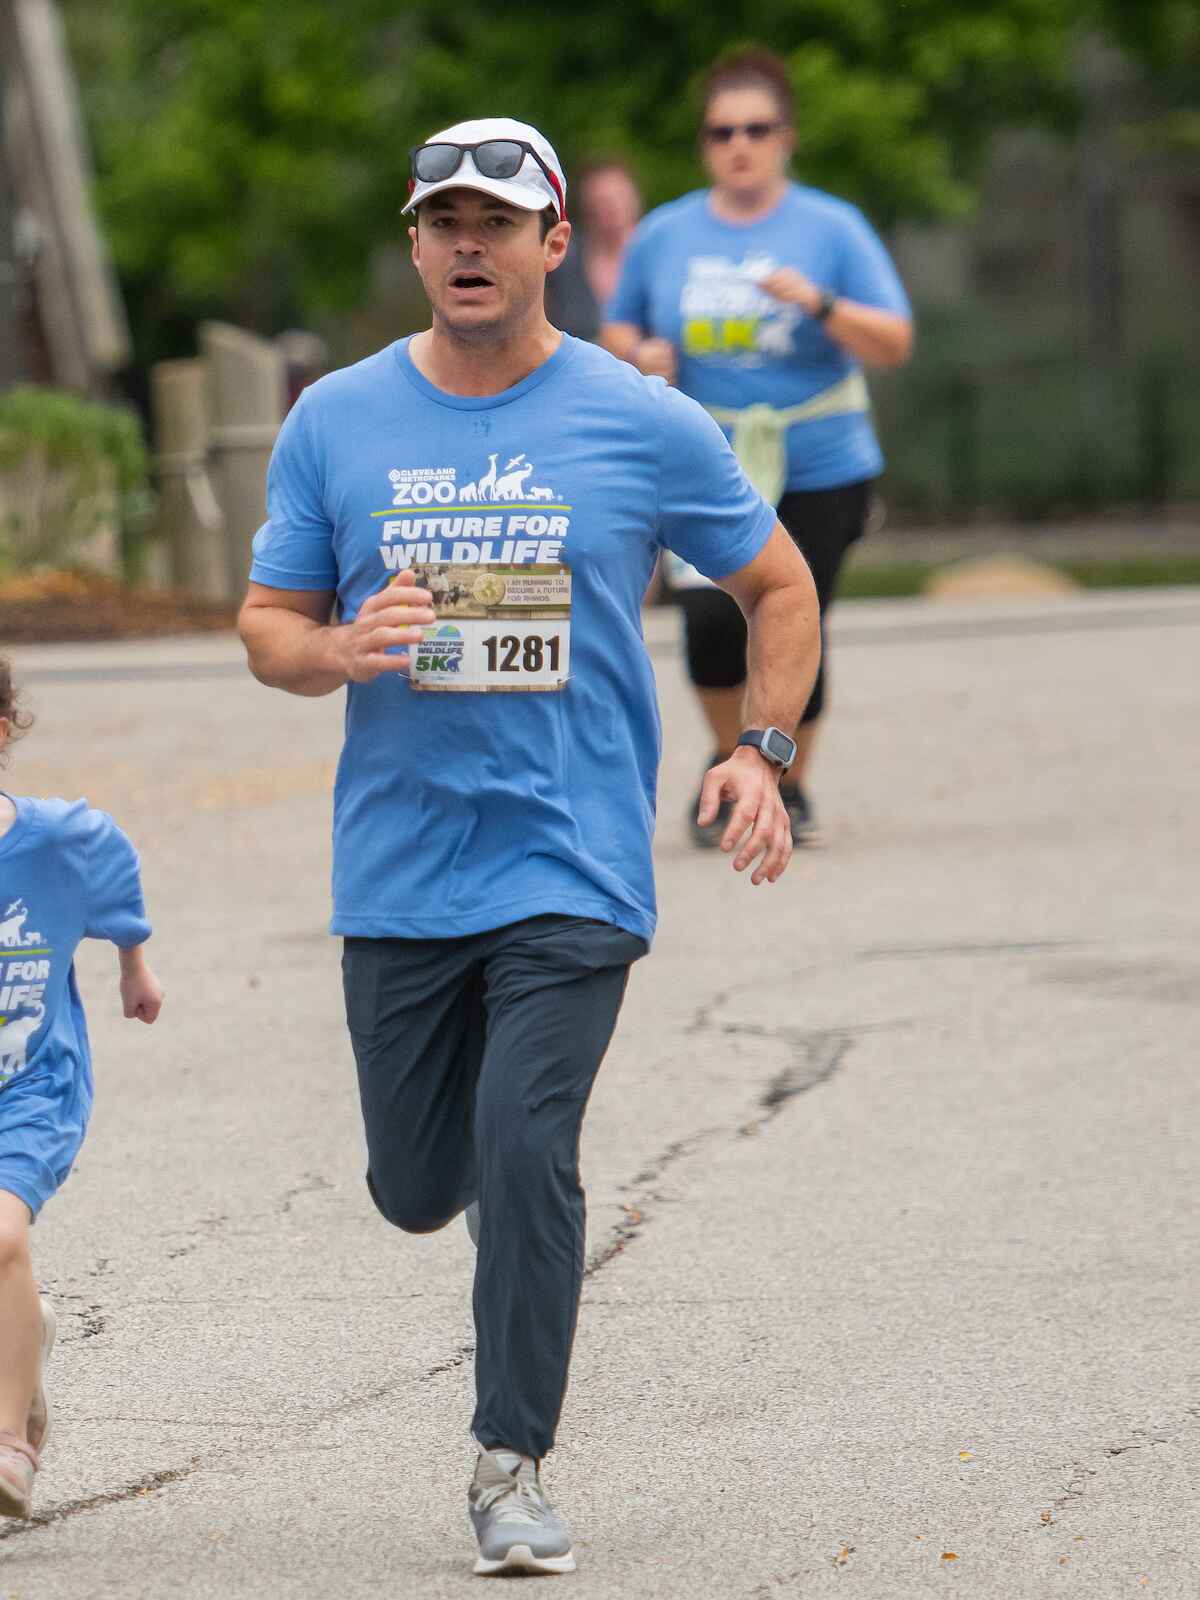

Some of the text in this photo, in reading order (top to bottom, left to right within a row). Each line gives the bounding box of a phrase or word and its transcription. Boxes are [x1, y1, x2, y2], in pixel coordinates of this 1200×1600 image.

[400, 468, 456, 476] CLEVELAND
[392, 481, 457, 505] ZOO
[382, 515, 570, 541] FUTURE FOR
[379, 540, 563, 570] WILDLIFE
[417, 647, 464, 655] WILDLIFE
[482, 634, 560, 672] 1281
[416, 656, 449, 672] 5K
[5, 959, 51, 982] FOR
